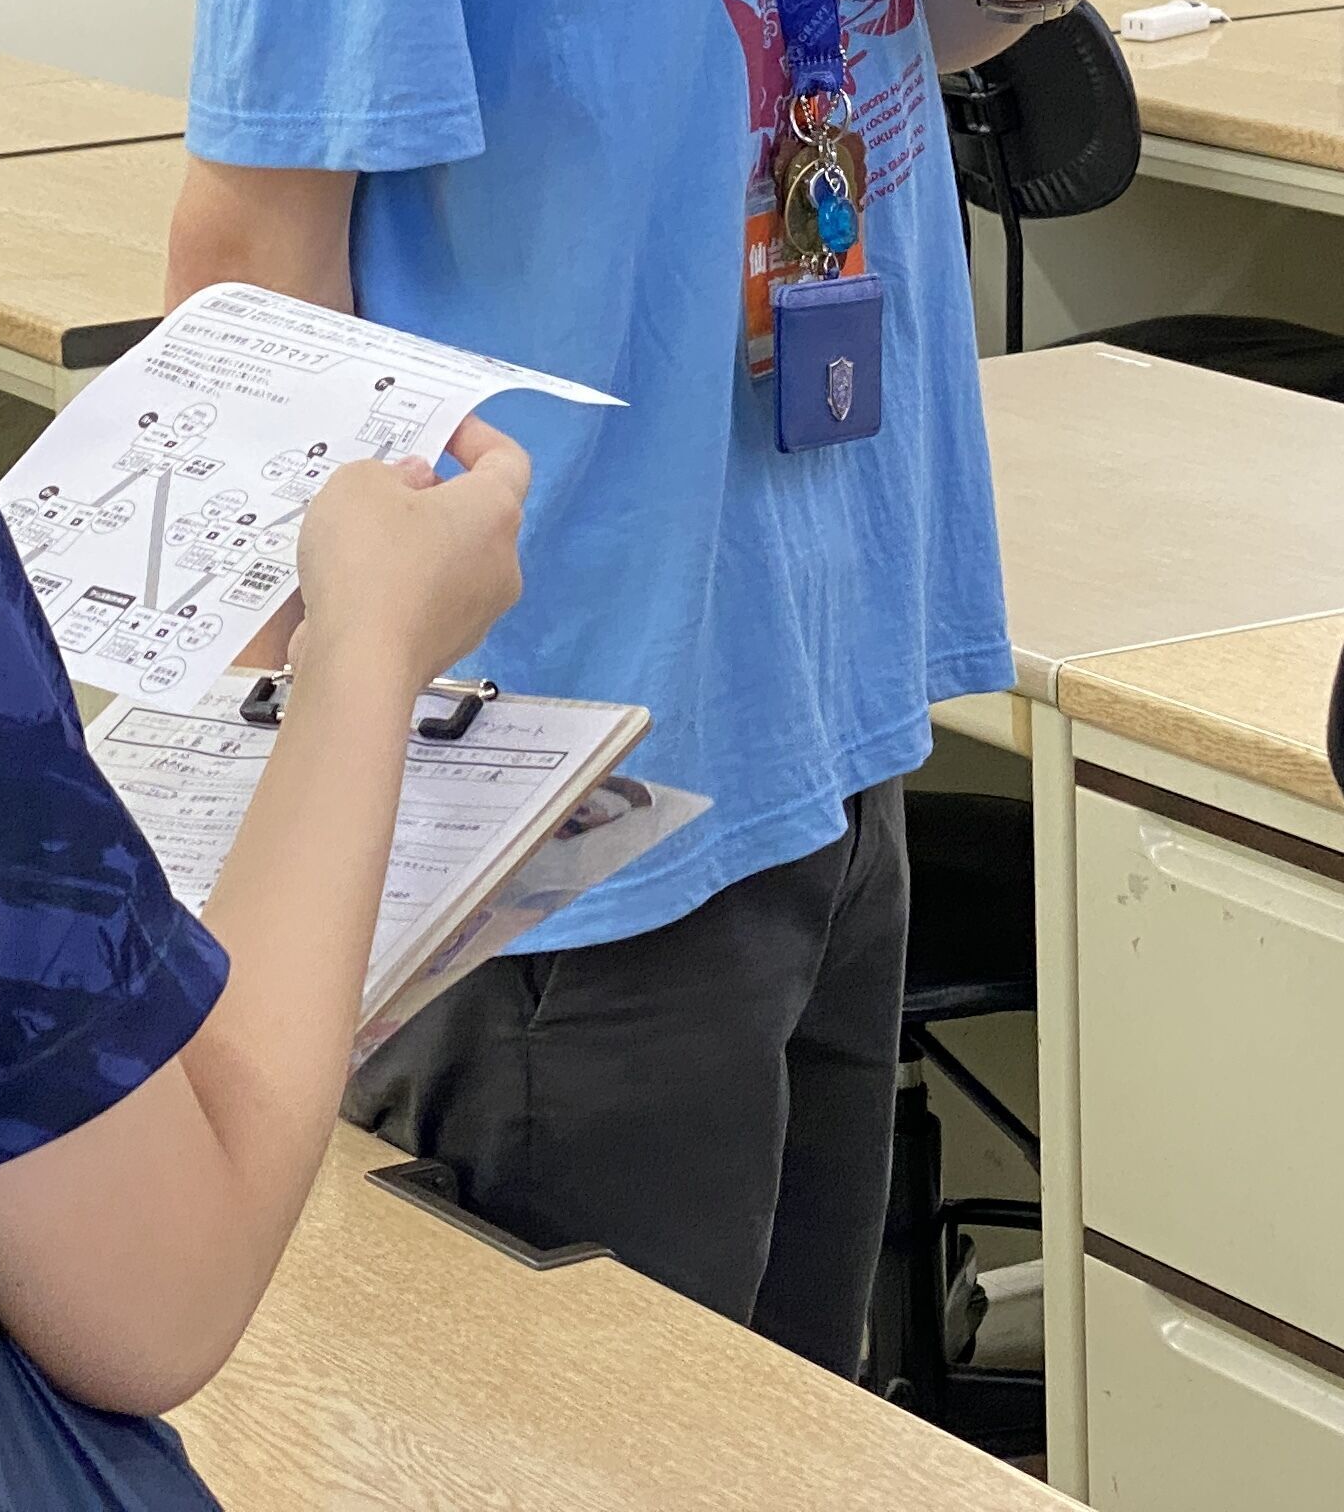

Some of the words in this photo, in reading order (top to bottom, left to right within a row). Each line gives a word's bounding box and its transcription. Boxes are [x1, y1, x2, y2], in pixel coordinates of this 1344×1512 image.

[250, 339, 329, 365] フロアマップ
